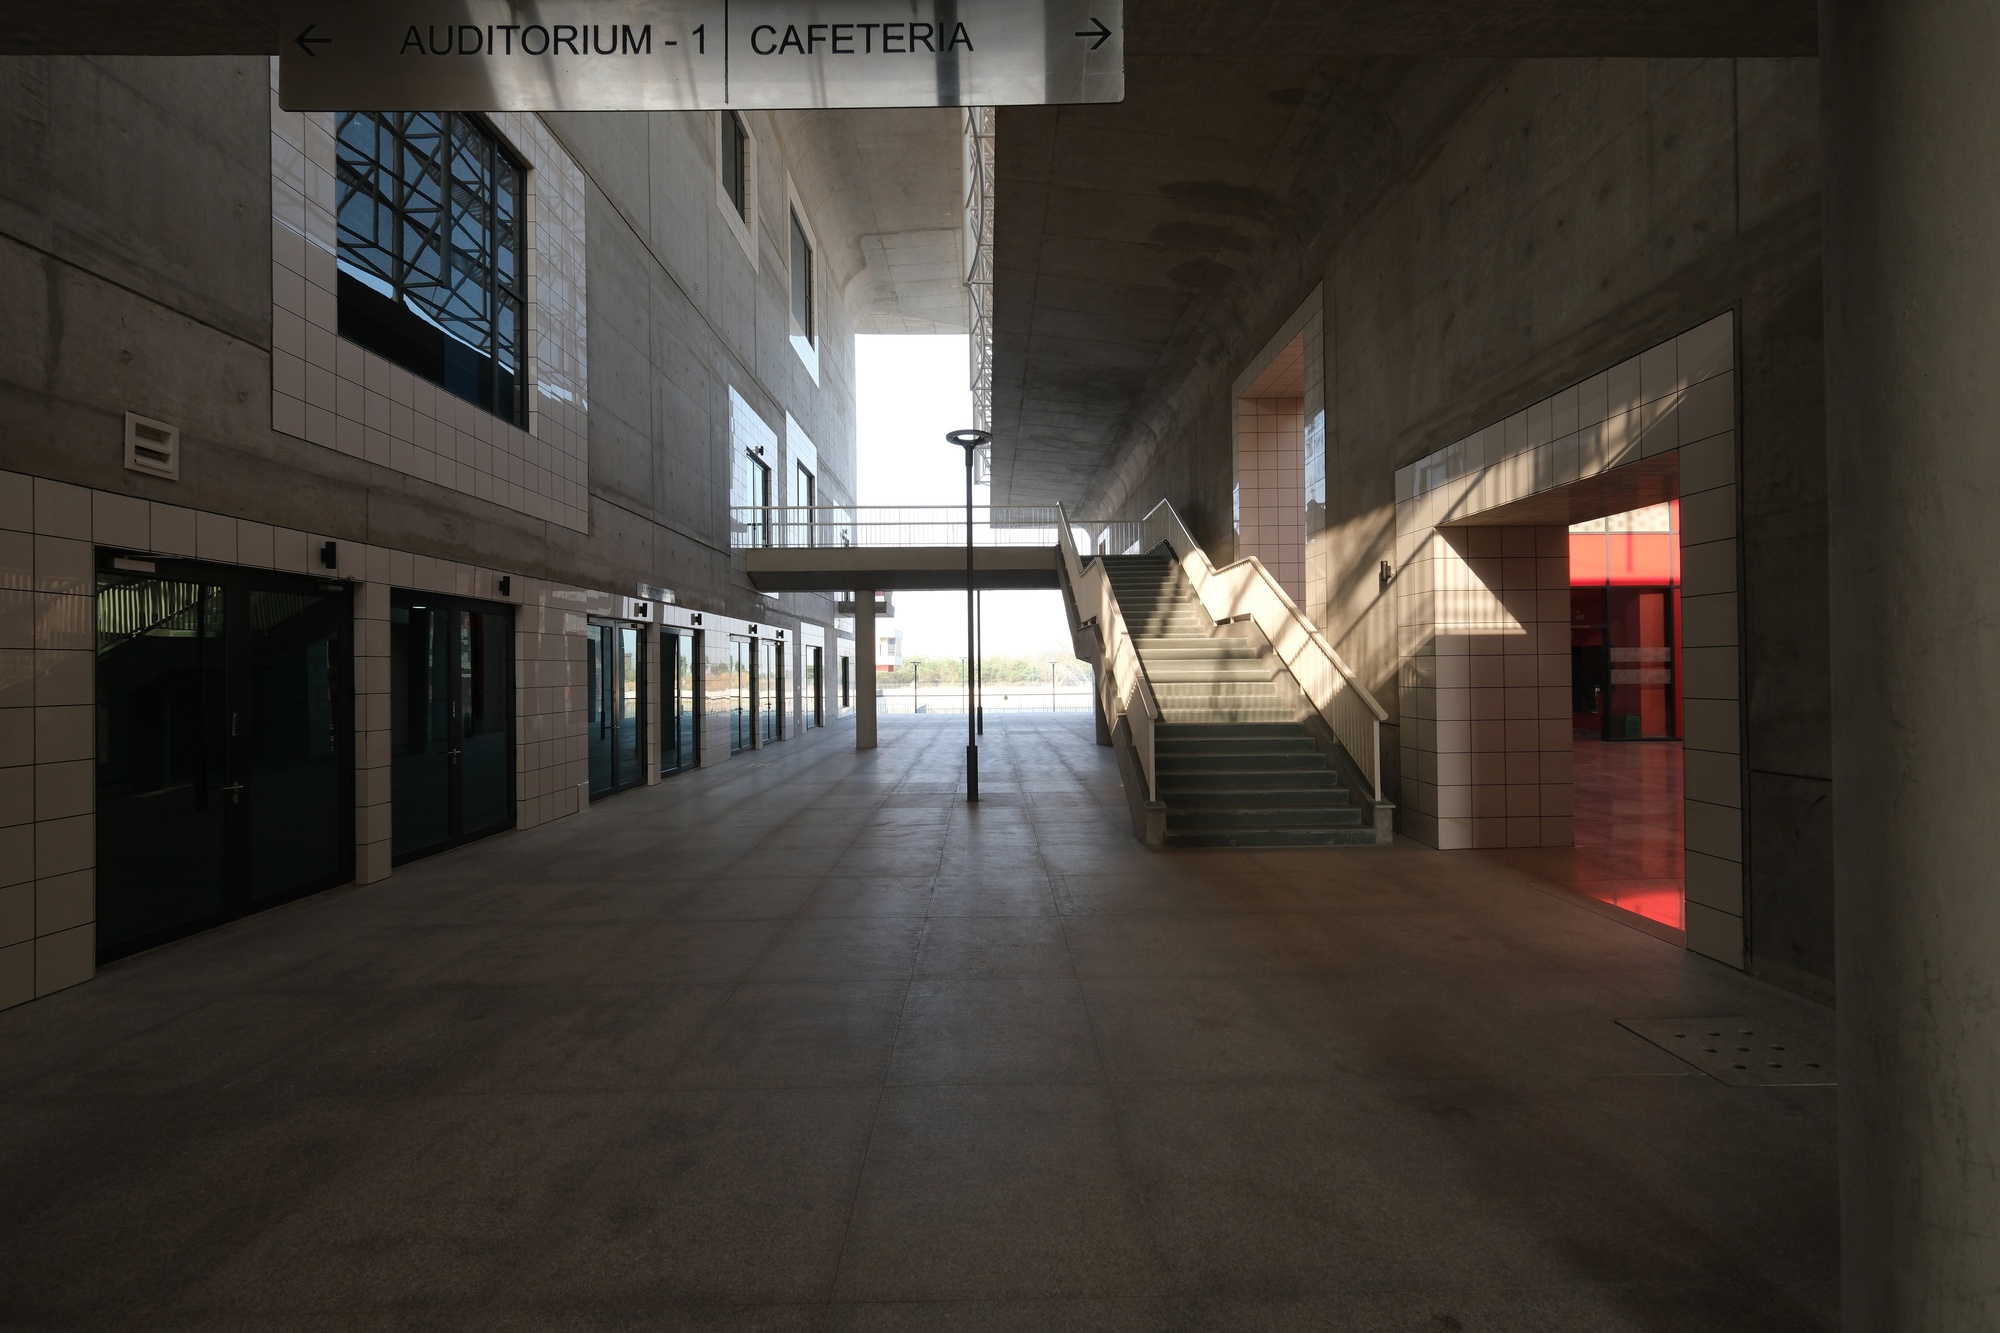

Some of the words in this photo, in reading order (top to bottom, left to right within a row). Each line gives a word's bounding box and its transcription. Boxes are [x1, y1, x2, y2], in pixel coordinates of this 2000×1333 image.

[400, 24, 652, 56] AUDITORIUM
[692, 23, 705, 55] 1
[750, 21, 975, 56] CAFETERIA
